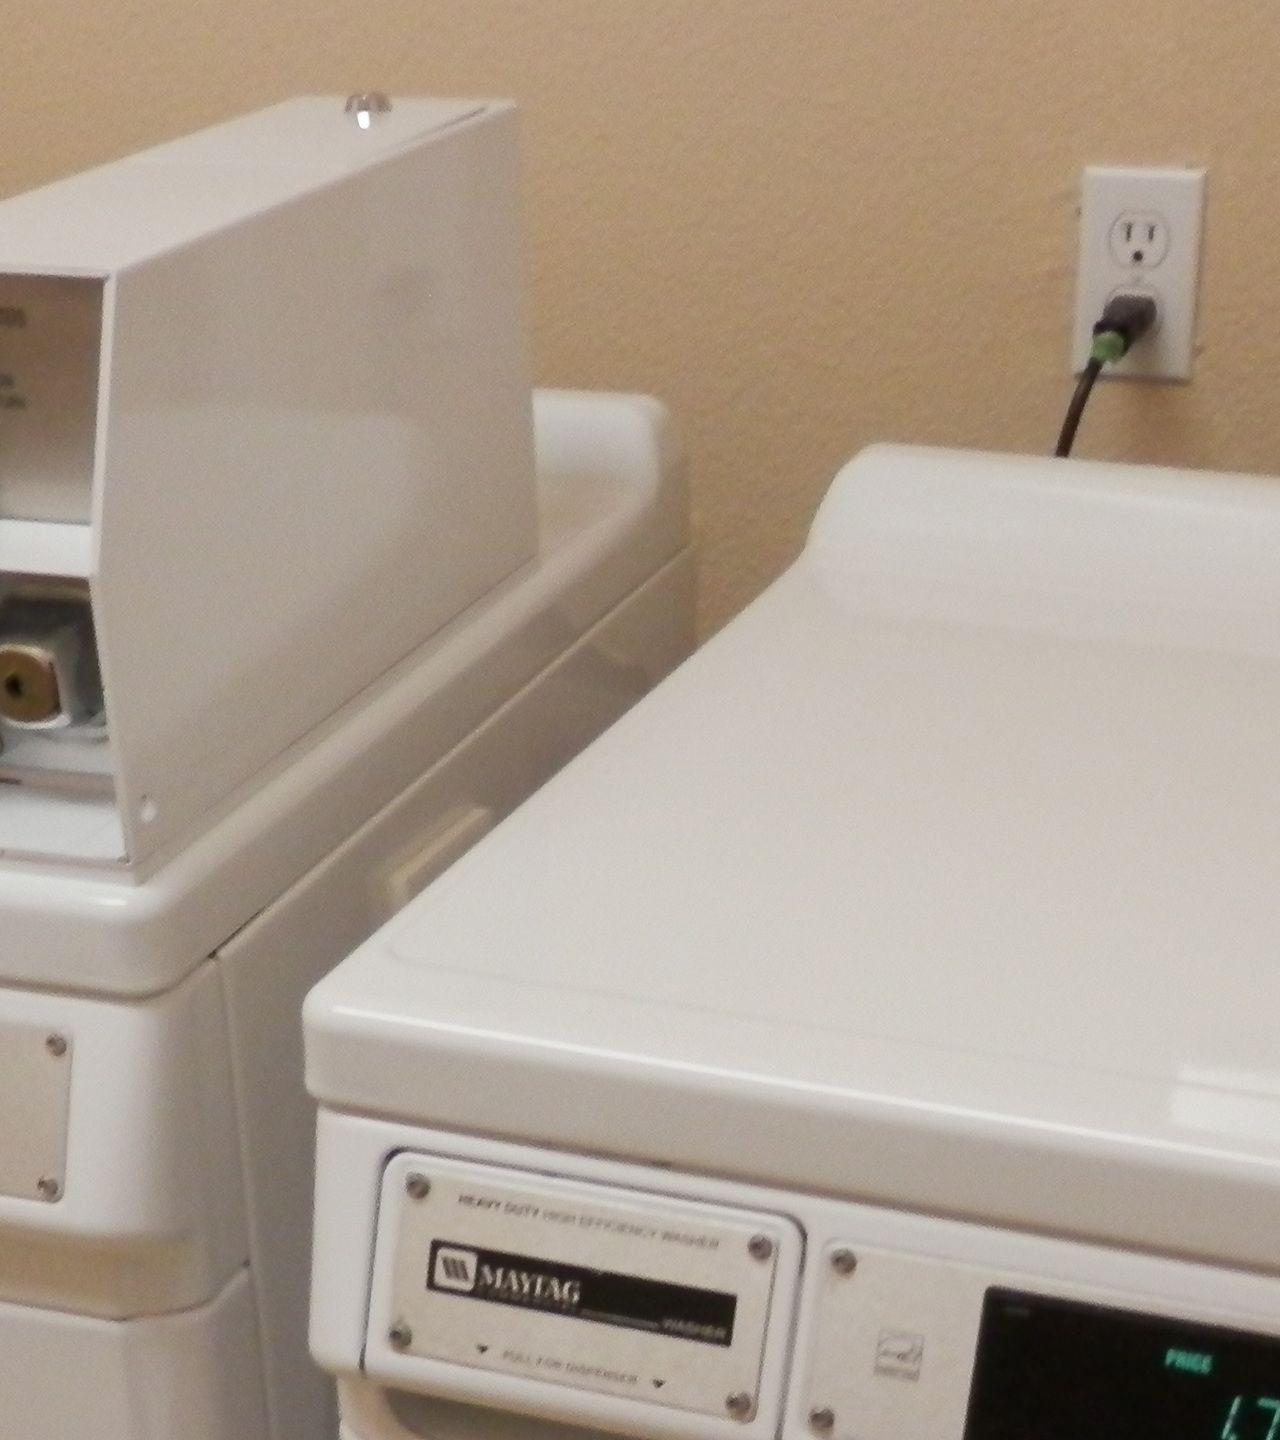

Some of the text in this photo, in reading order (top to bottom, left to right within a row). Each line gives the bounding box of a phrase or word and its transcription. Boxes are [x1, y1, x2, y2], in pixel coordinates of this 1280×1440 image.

[504, 1201, 539, 1217] DUTY
[661, 1230, 719, 1249] WASHER
[479, 1264, 580, 1304] MAYTAG
[662, 1318, 727, 1340] WASHER
[1165, 1348, 1213, 1375] PRICE
